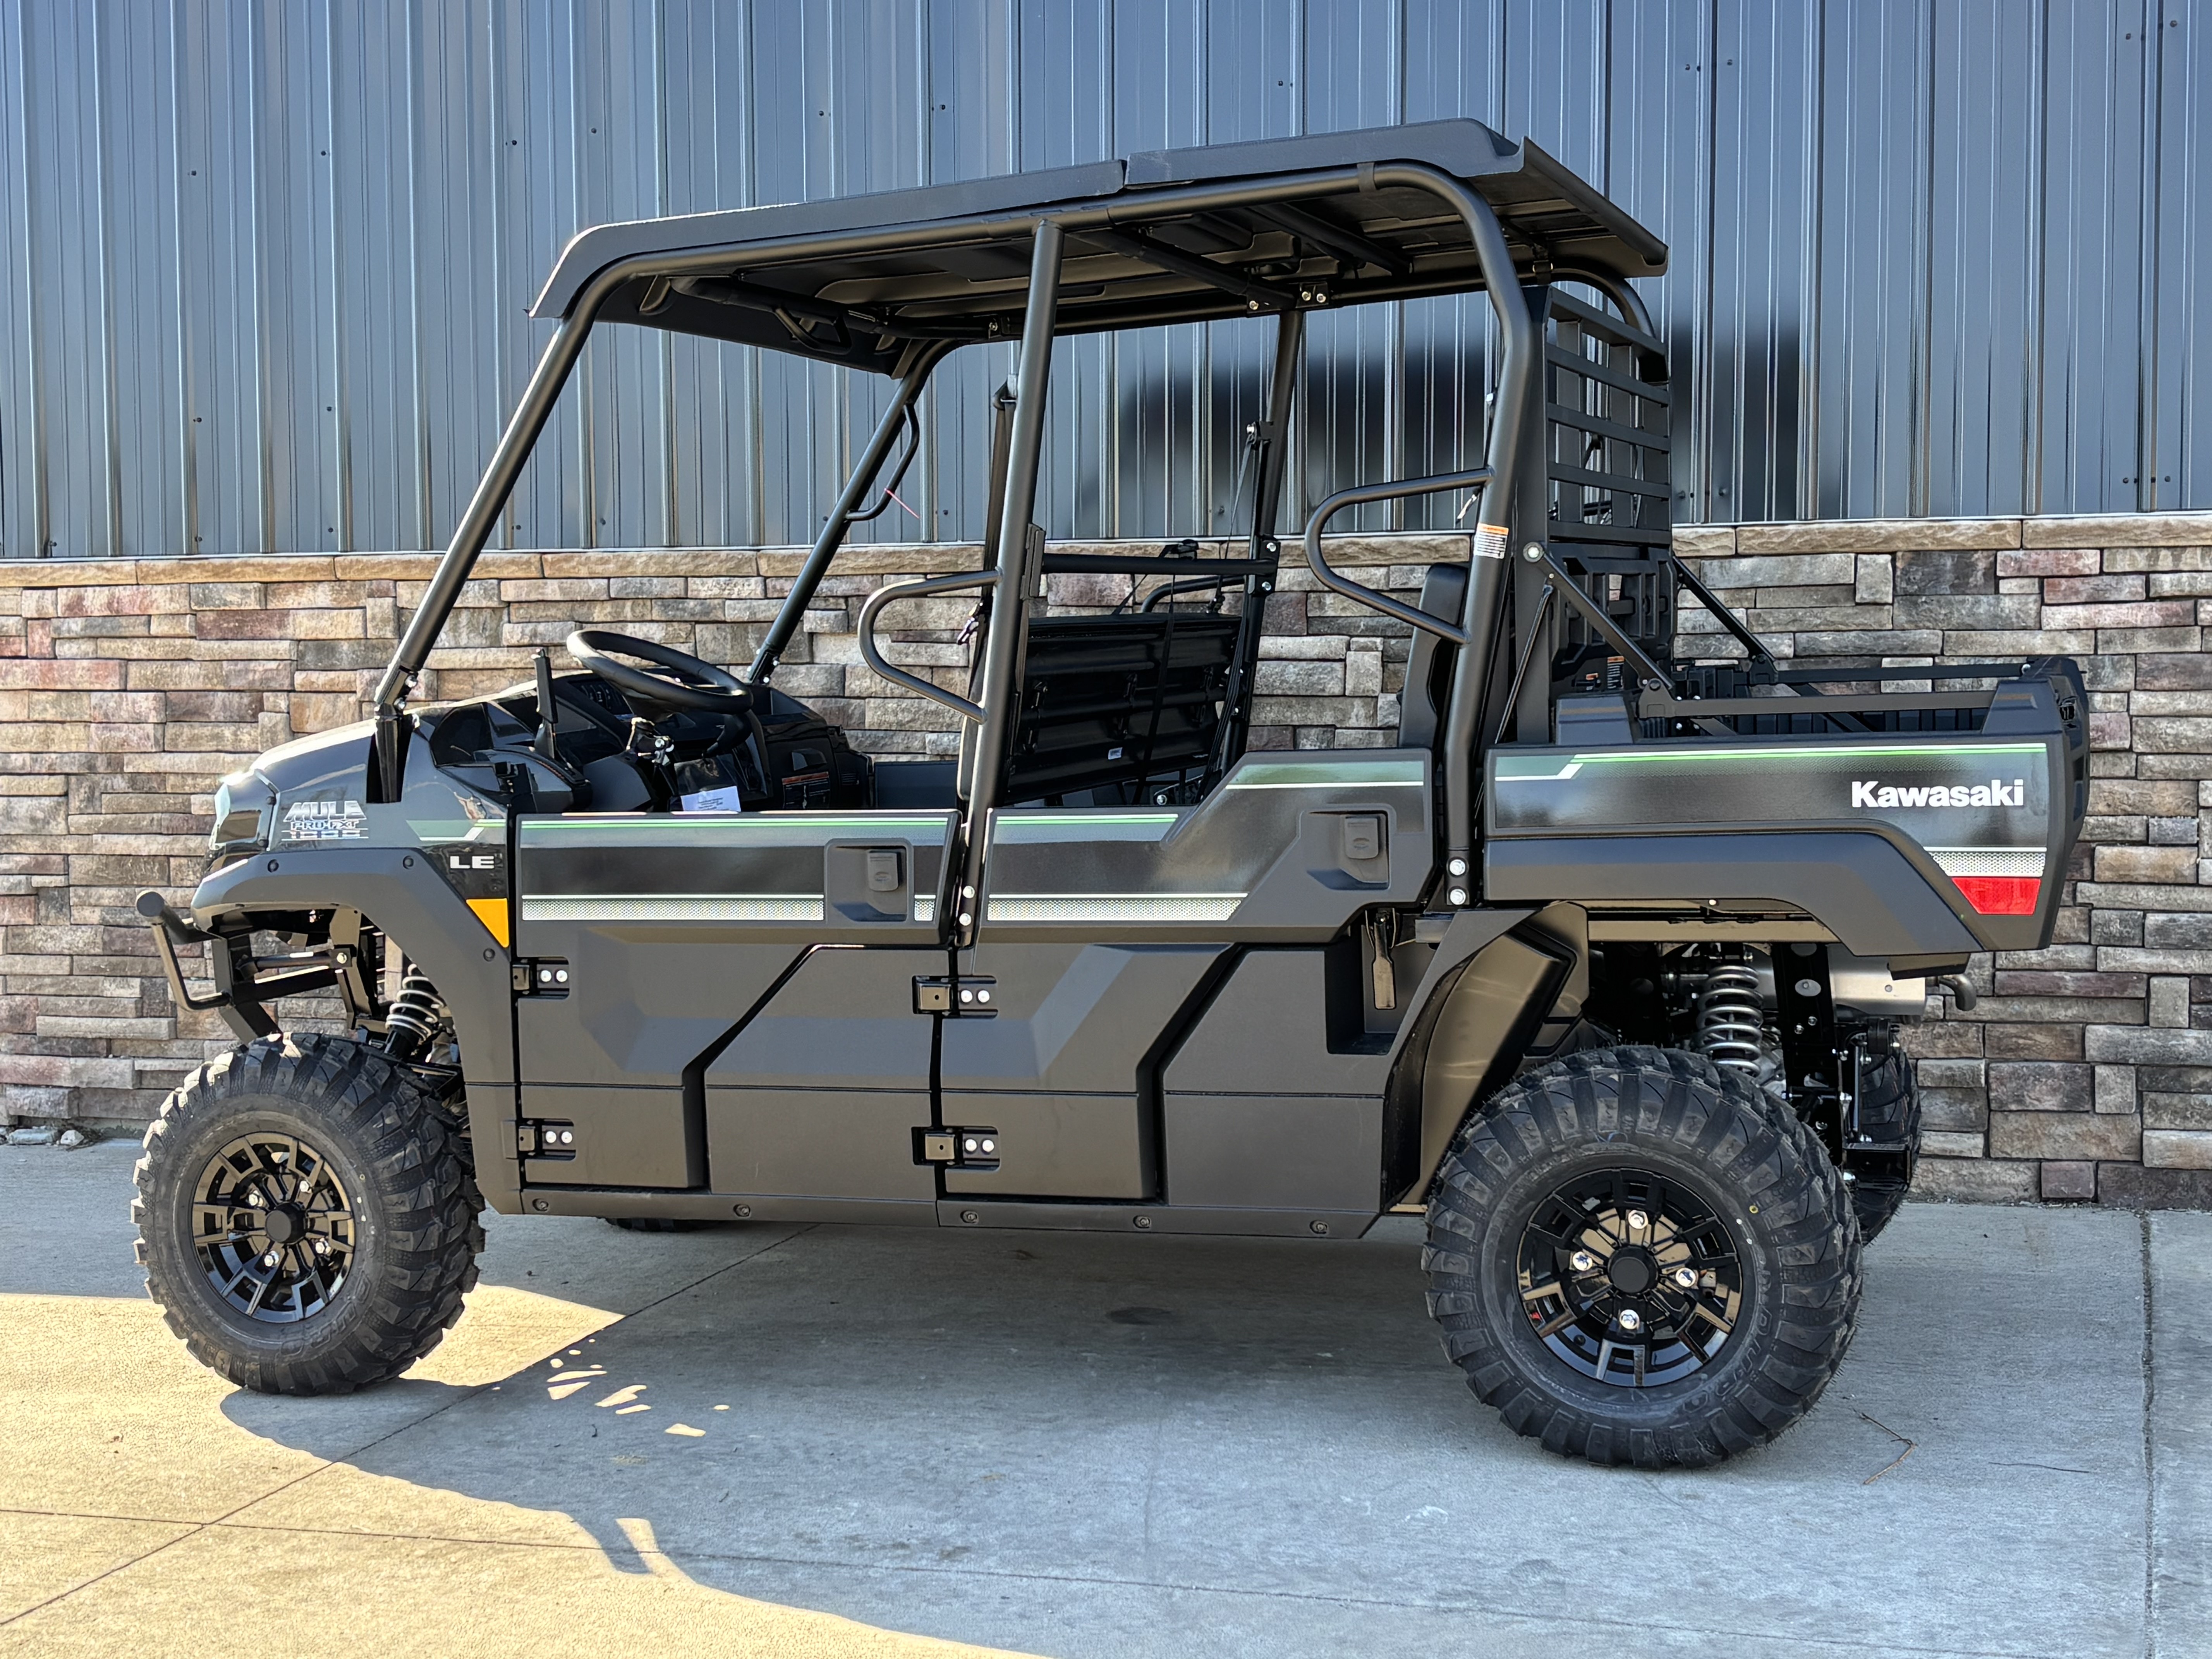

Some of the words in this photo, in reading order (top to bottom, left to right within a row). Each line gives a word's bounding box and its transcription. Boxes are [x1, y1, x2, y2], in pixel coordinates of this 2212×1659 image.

[1851, 779, 2023, 808] Kawasaki
[283, 800, 367, 822] MULE
[450, 855, 494, 869] LE
